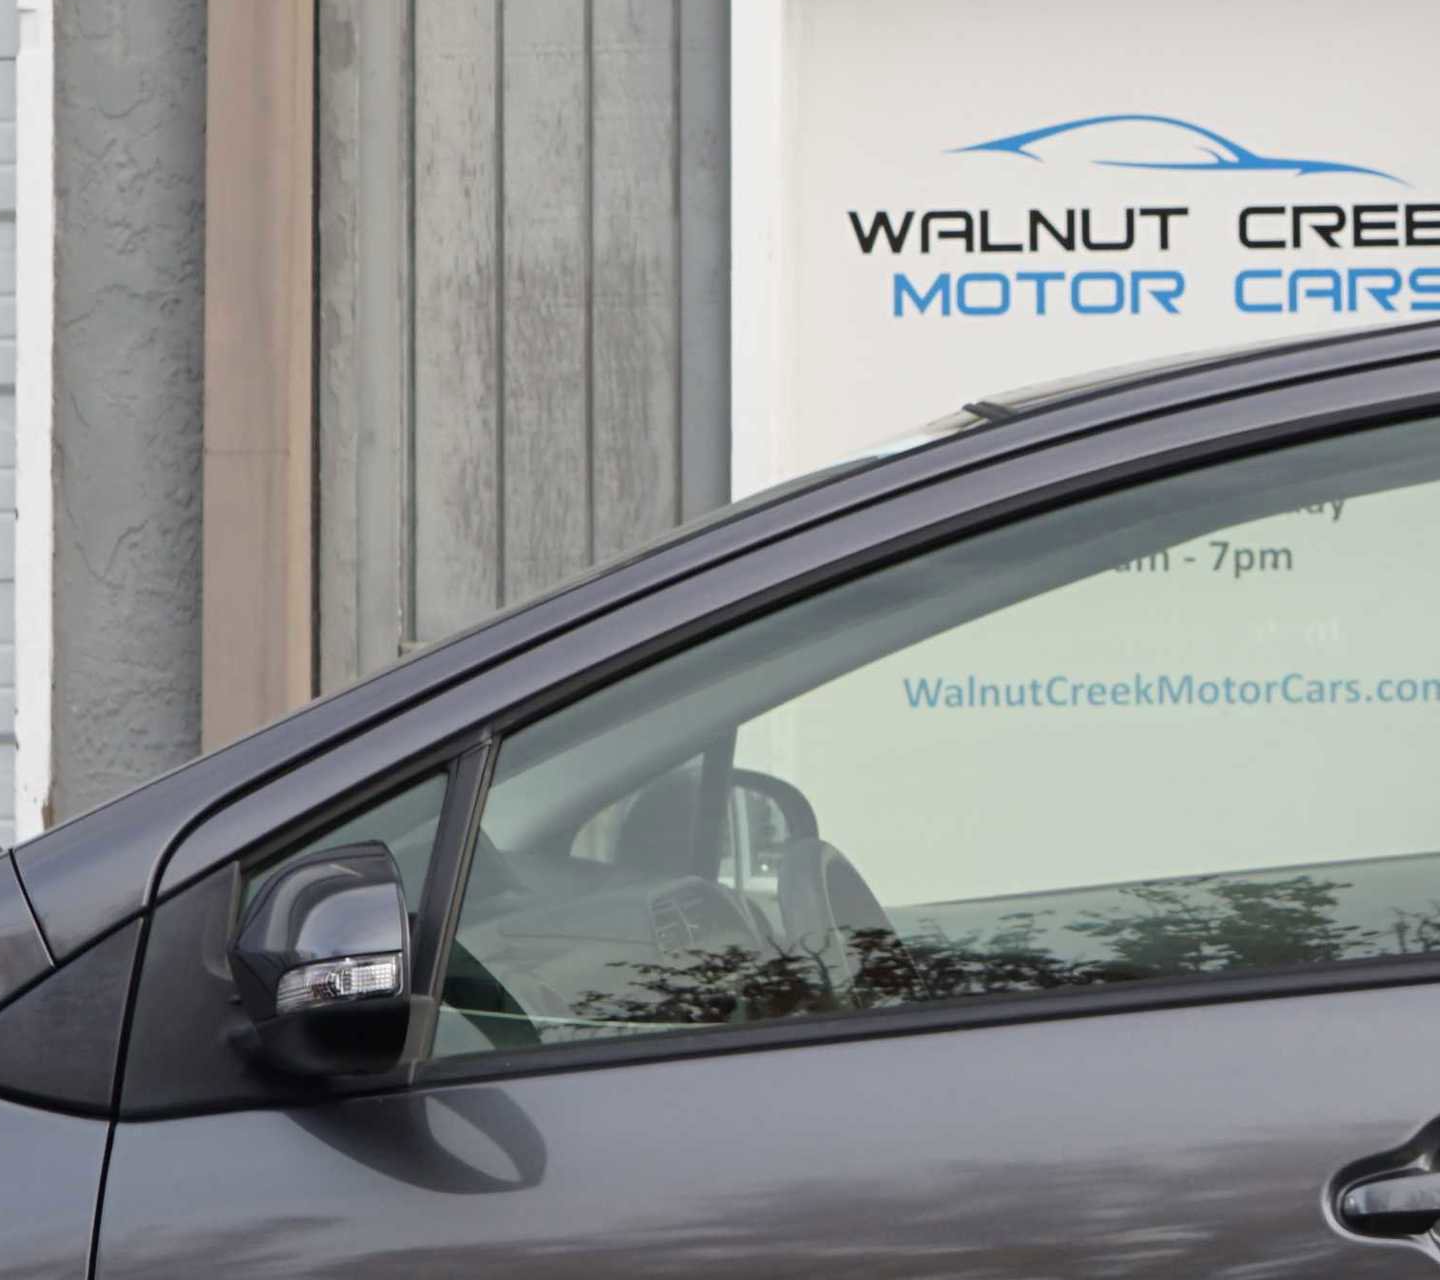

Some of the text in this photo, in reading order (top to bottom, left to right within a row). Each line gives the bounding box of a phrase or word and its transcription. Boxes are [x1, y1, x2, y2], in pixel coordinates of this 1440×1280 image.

[848, 207, 1189, 254] WALNUT
[892, 271, 1185, 317] MOTOR
[1208, 540, 1294, 579] 7pm
